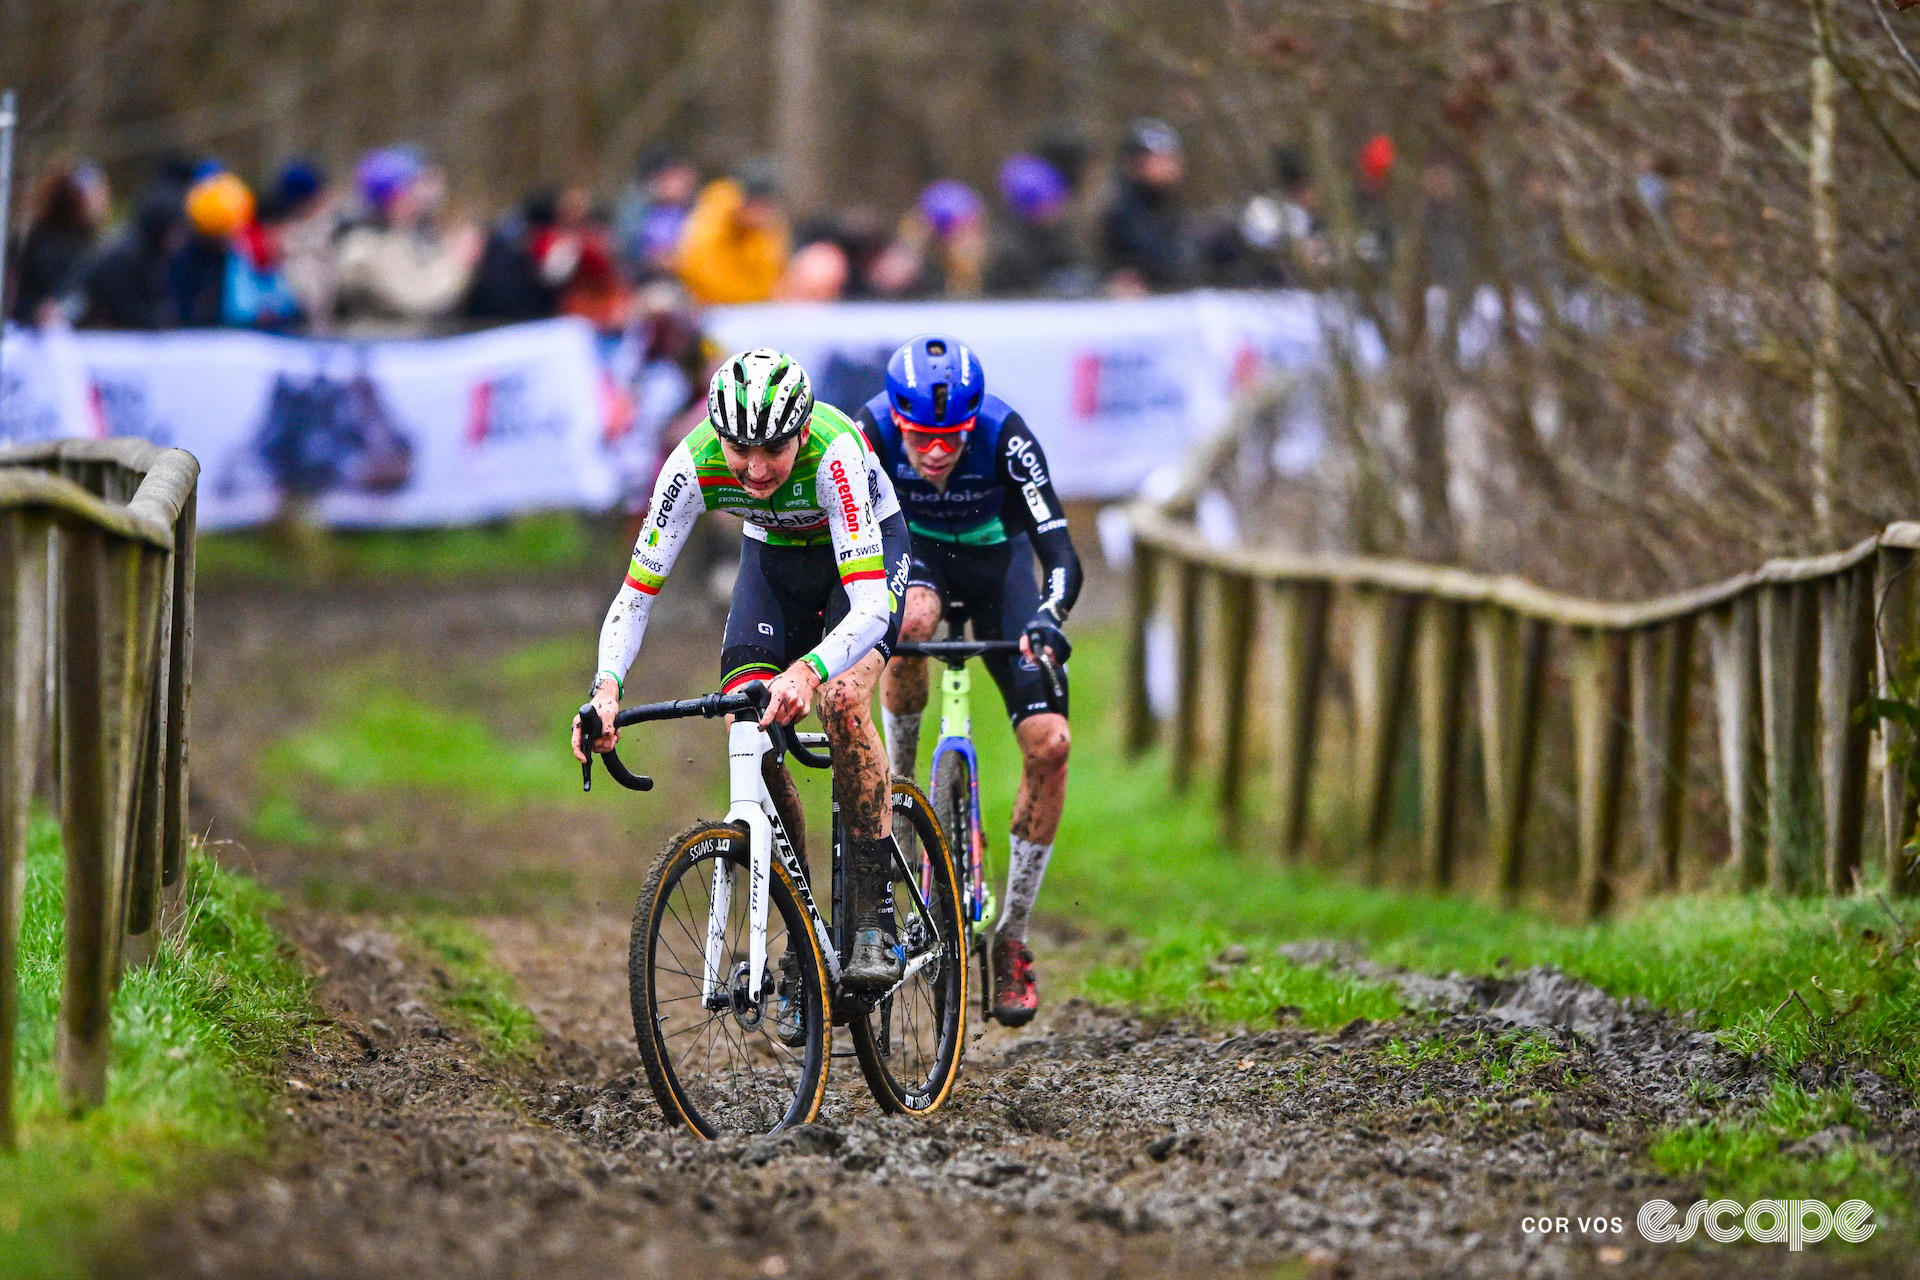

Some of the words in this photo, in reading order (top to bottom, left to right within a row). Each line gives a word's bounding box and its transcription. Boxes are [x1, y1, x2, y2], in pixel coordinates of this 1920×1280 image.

[1005, 435, 1049, 488] glowi
[656, 472, 687, 528] crelan
[829, 460, 859, 533] corendon
[639, 554, 664, 573] SWISS
[840, 549, 853, 561] DT
[855, 543, 880, 557] SWISS
[903, 793, 913, 810] DT
[689, 838, 714, 862] SWISS
[715, 838, 731, 852] DT
[768, 814, 820, 921] STEVENS
[752, 857, 764, 914] STEVENS
[905, 1093, 915, 1109] DT
